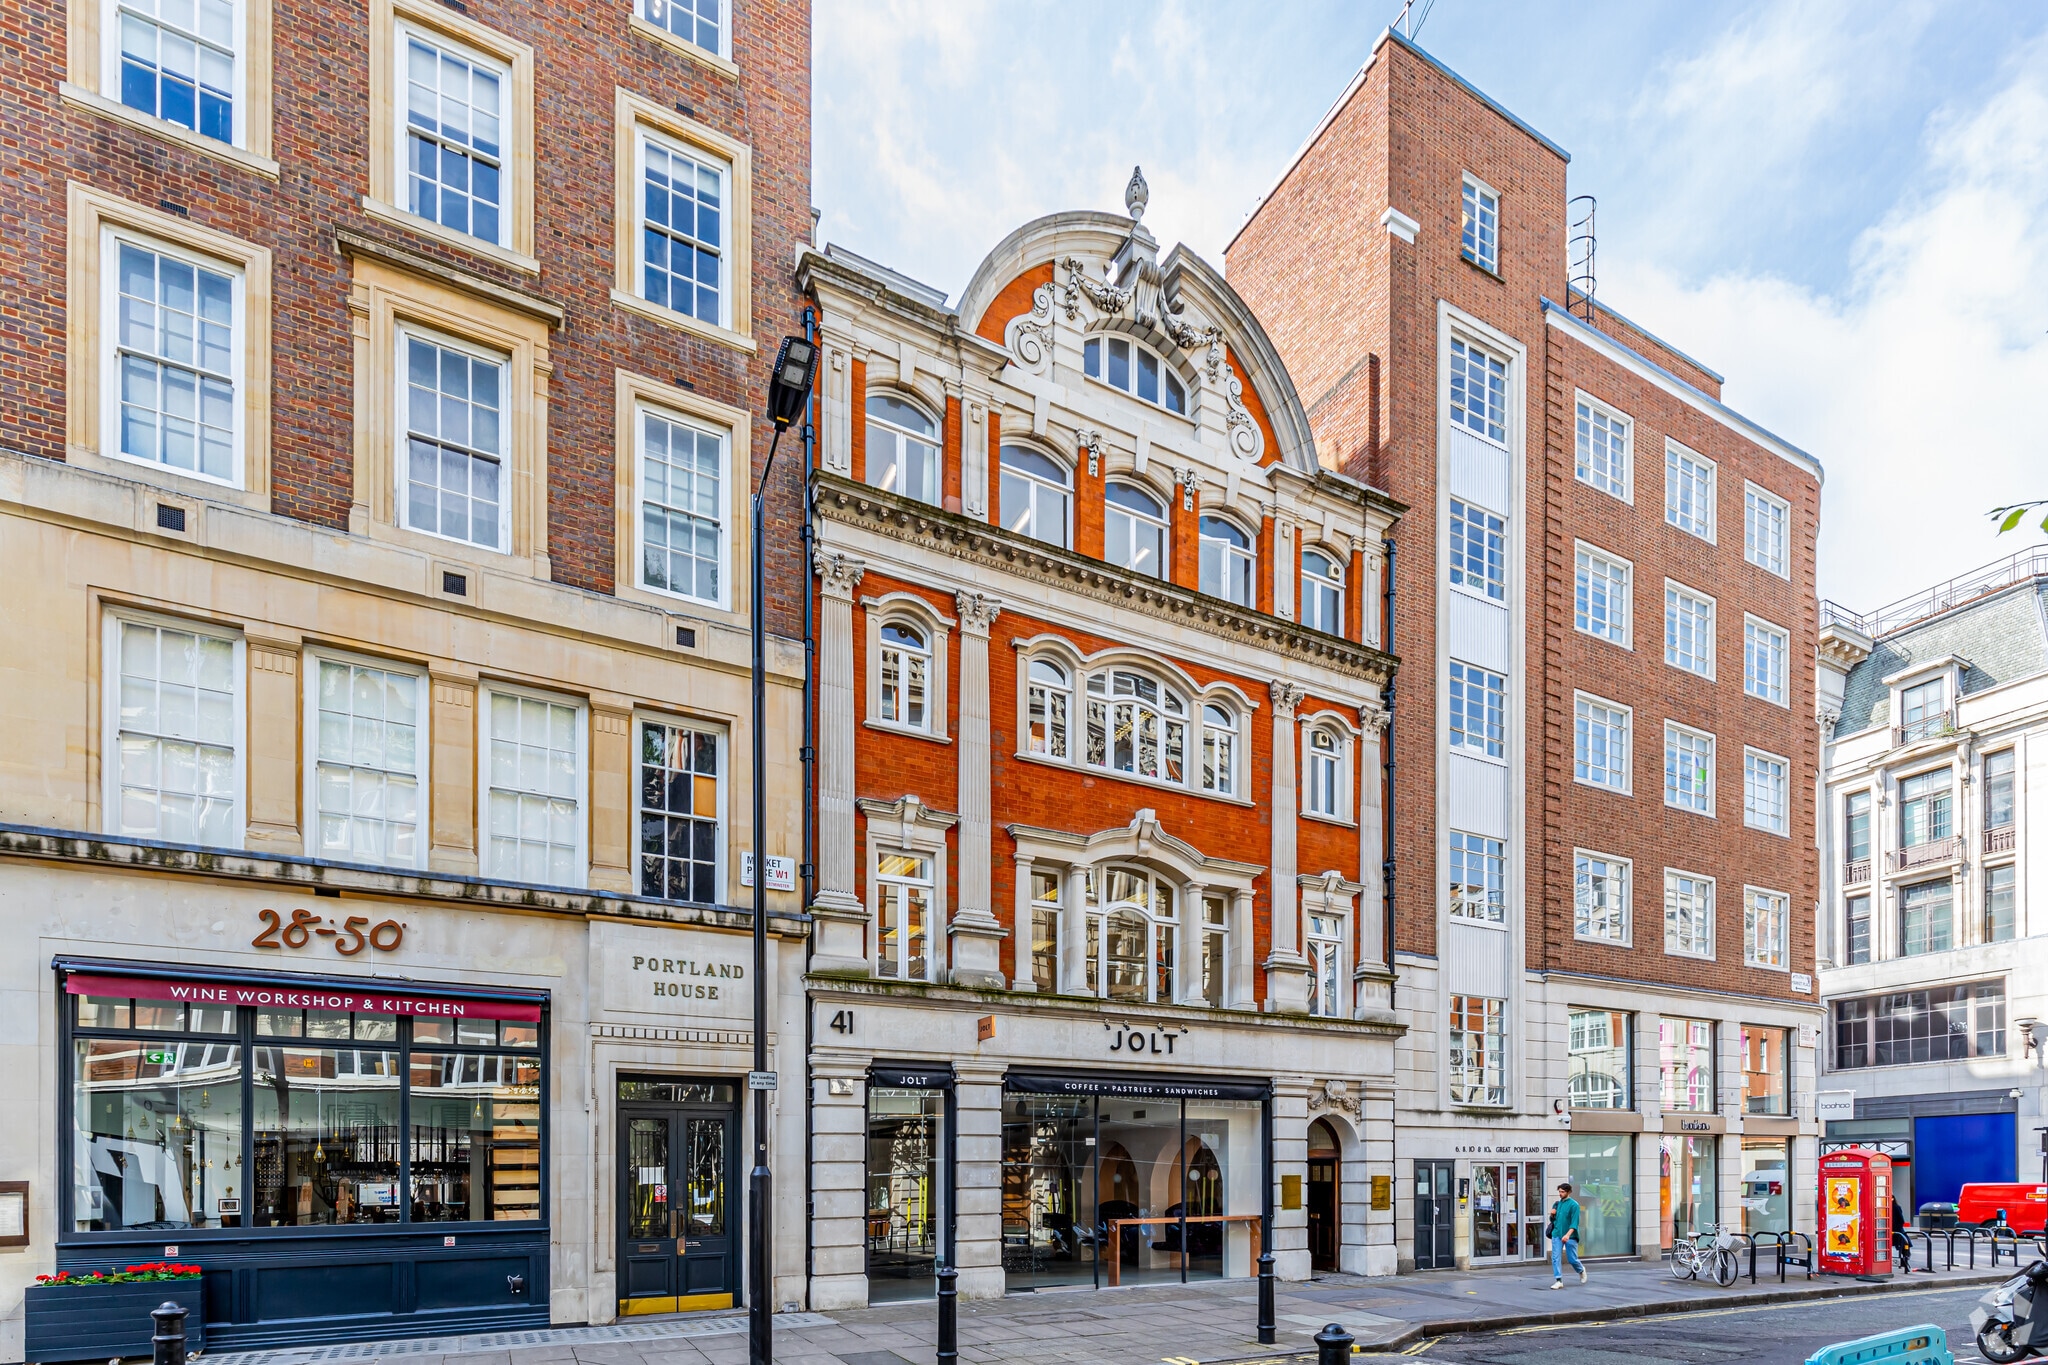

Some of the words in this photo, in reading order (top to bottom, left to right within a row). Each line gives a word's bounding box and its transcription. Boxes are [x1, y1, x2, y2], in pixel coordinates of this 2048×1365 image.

[746, 856, 782, 868] MKET
[776, 870, 788, 879] W1
[632, 956, 744, 979] PORTLAND
[653, 982, 718, 1000] HOUSE
[170, 986, 227, 1001] WINE
[236, 990, 353, 1008] WORKSHOP
[363, 999, 373, 1010] &
[383, 1000, 465, 1015] KITCHEN
[830, 1010, 853, 1034] 41
[980, 1023, 991, 1032] JOLT
[1110, 1031, 1178, 1054] JOLT
[900, 1076, 928, 1085] JOLT
[1065, 1083, 1099, 1091] COFFEE
[1112, 1085, 1153, 1093] PASTRIES
[1165, 1088, 1218, 1096] SANDWICHES
